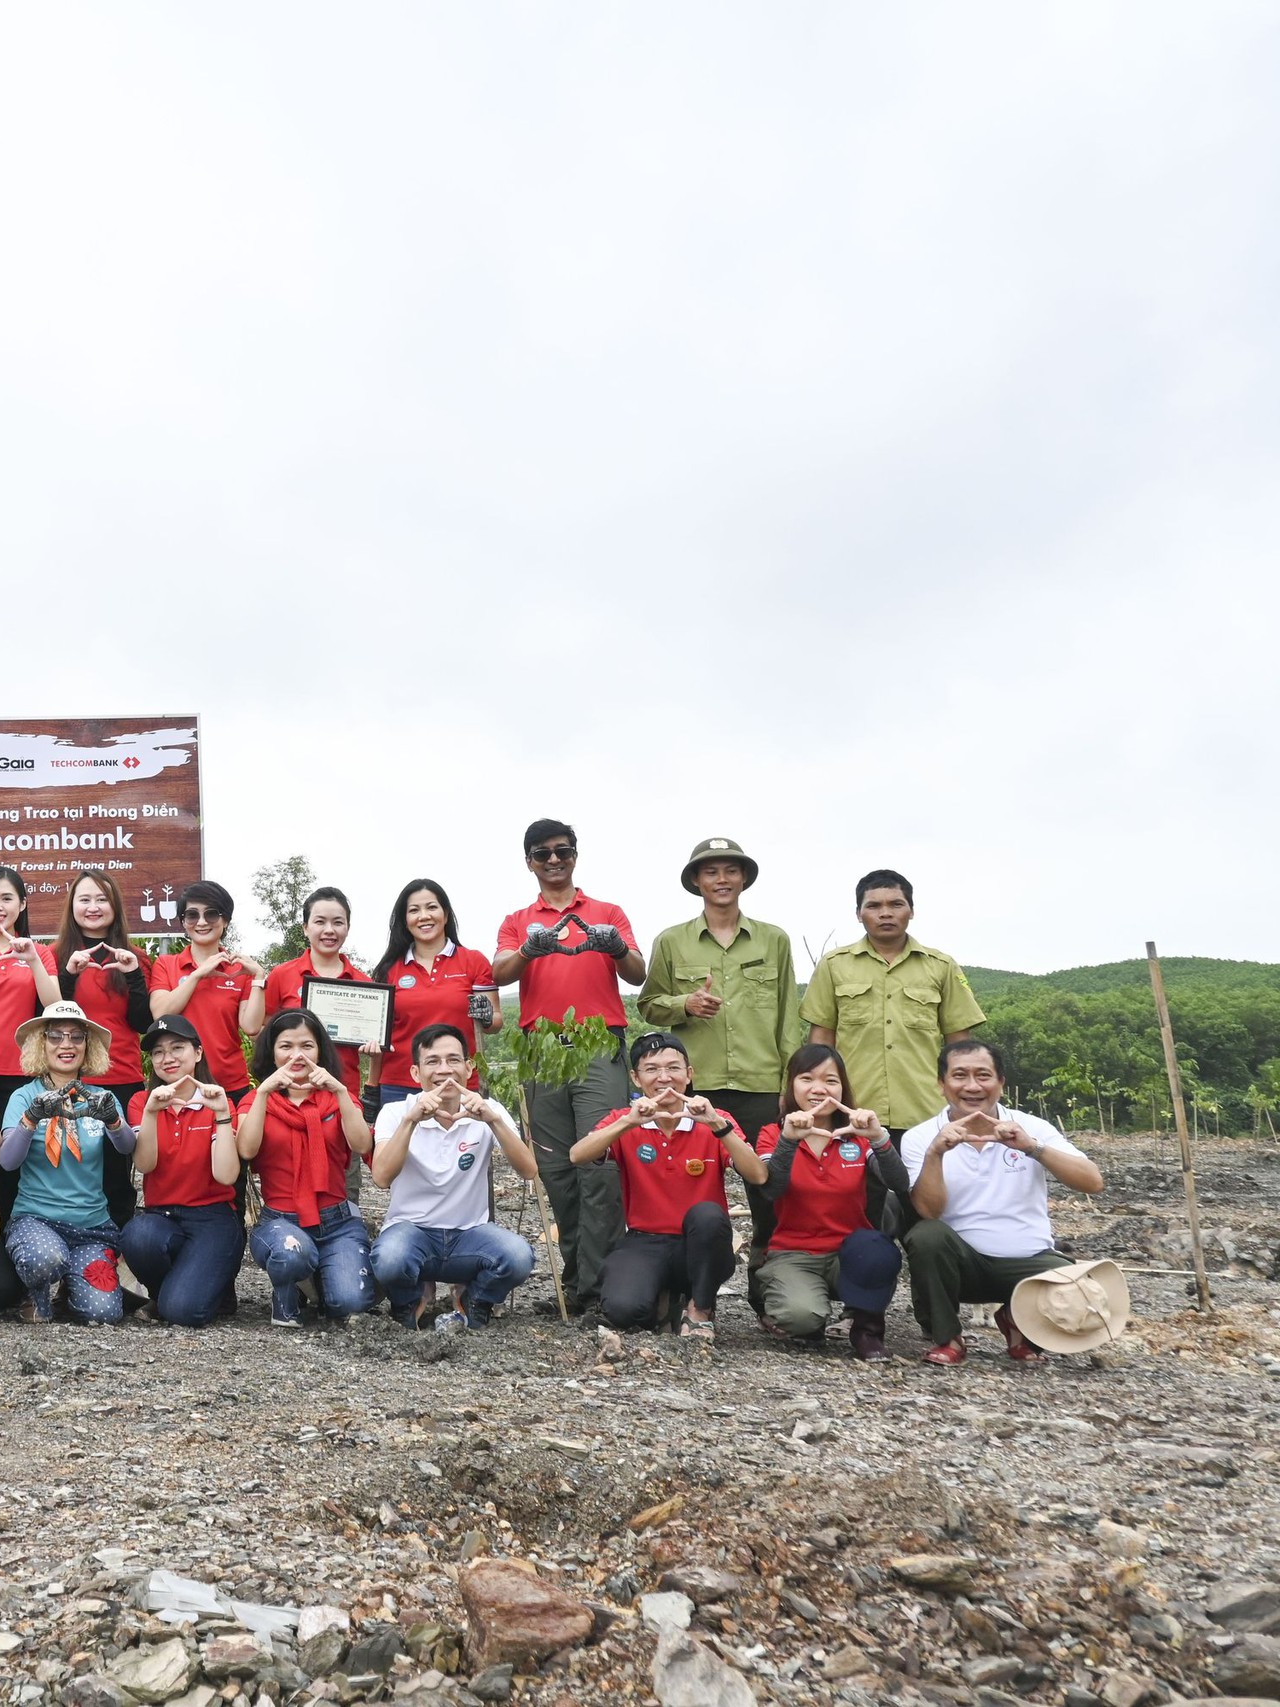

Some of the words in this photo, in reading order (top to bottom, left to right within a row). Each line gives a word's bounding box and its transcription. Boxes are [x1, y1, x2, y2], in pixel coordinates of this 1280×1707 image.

[50, 759, 119, 768] TECHCOMBANK
[24, 806, 59, 819] Trao
[63, 806, 84, 821] tại
[89, 805, 138, 820] Phong
[142, 803, 179, 817] Điền
[20, 861, 54, 871] Forest
[57, 861, 67, 870] in
[108, 860, 133, 869] Dien
[39, 882, 61, 895] đây:
[316, 989, 349, 997] CERTIFICATE
[55, 1006, 80, 1016] Gaia
